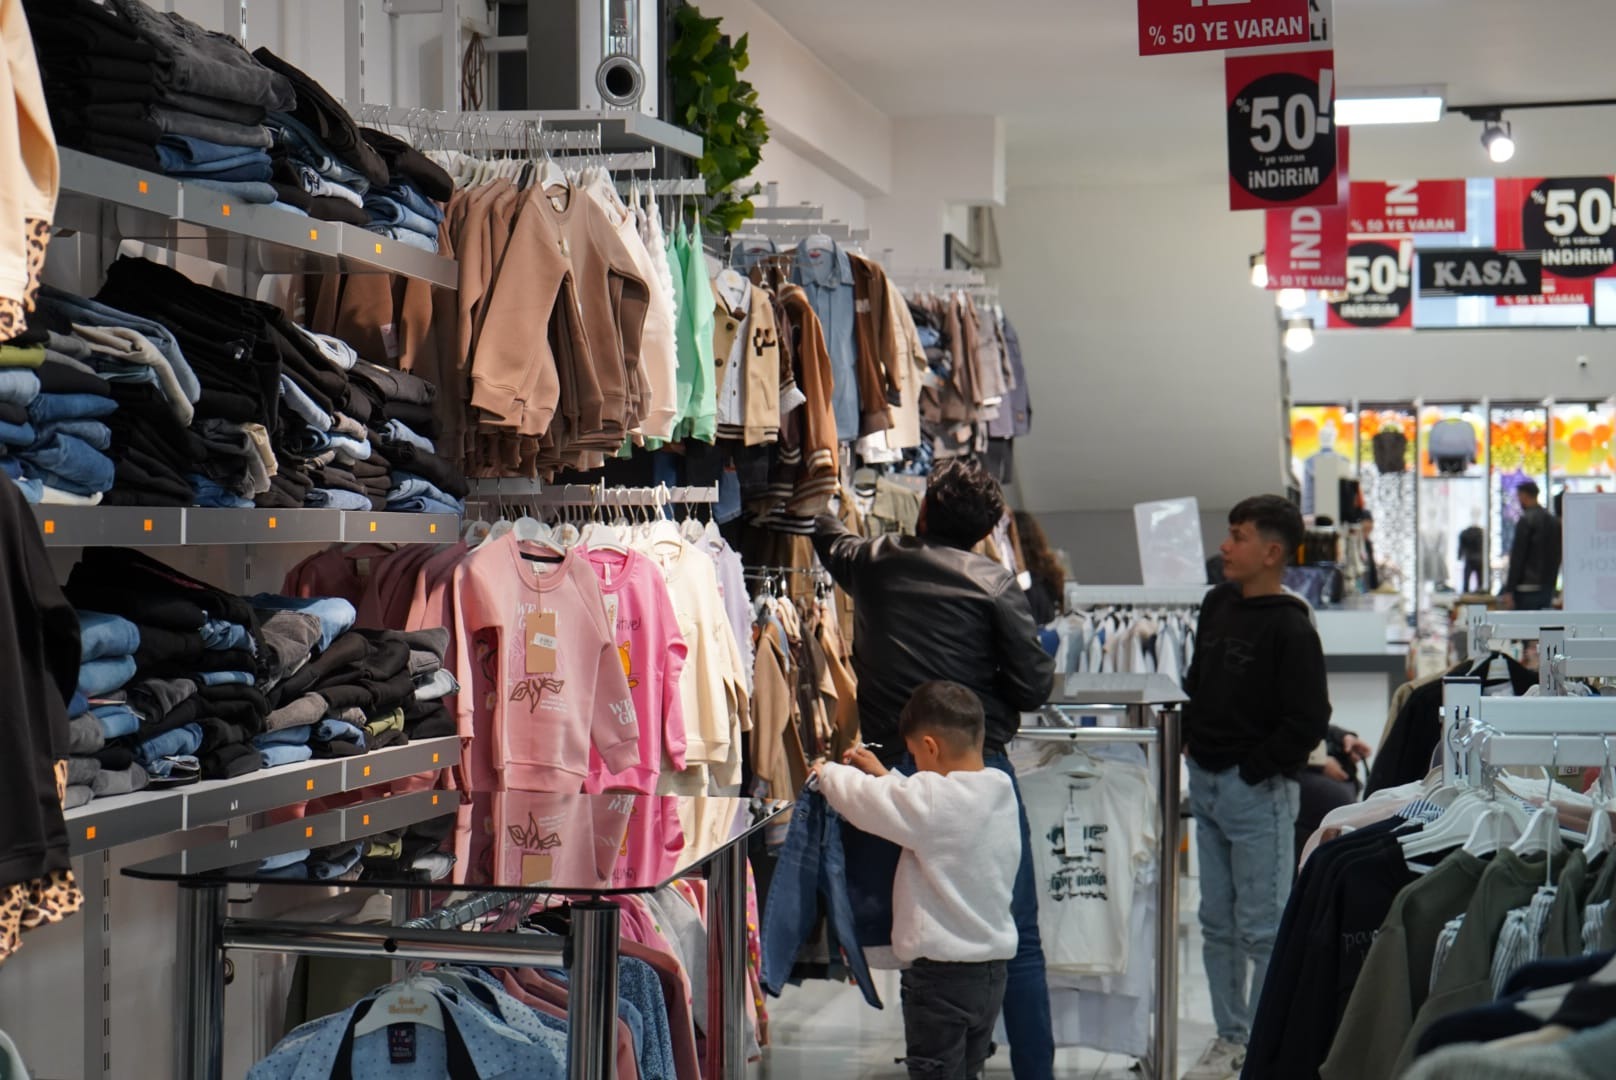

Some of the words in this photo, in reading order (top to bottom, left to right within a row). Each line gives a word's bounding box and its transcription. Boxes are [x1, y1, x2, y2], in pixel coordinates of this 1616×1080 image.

[1149, 26, 1166, 46] %
[1172, 24, 1196, 44] 50
[1202, 21, 1228, 41] YE
[1234, 16, 1303, 40] VARAN
[1387, 219, 1405, 231] YE
[1409, 218, 1456, 231] VARAN
[1433, 259, 1527, 287] KASA
